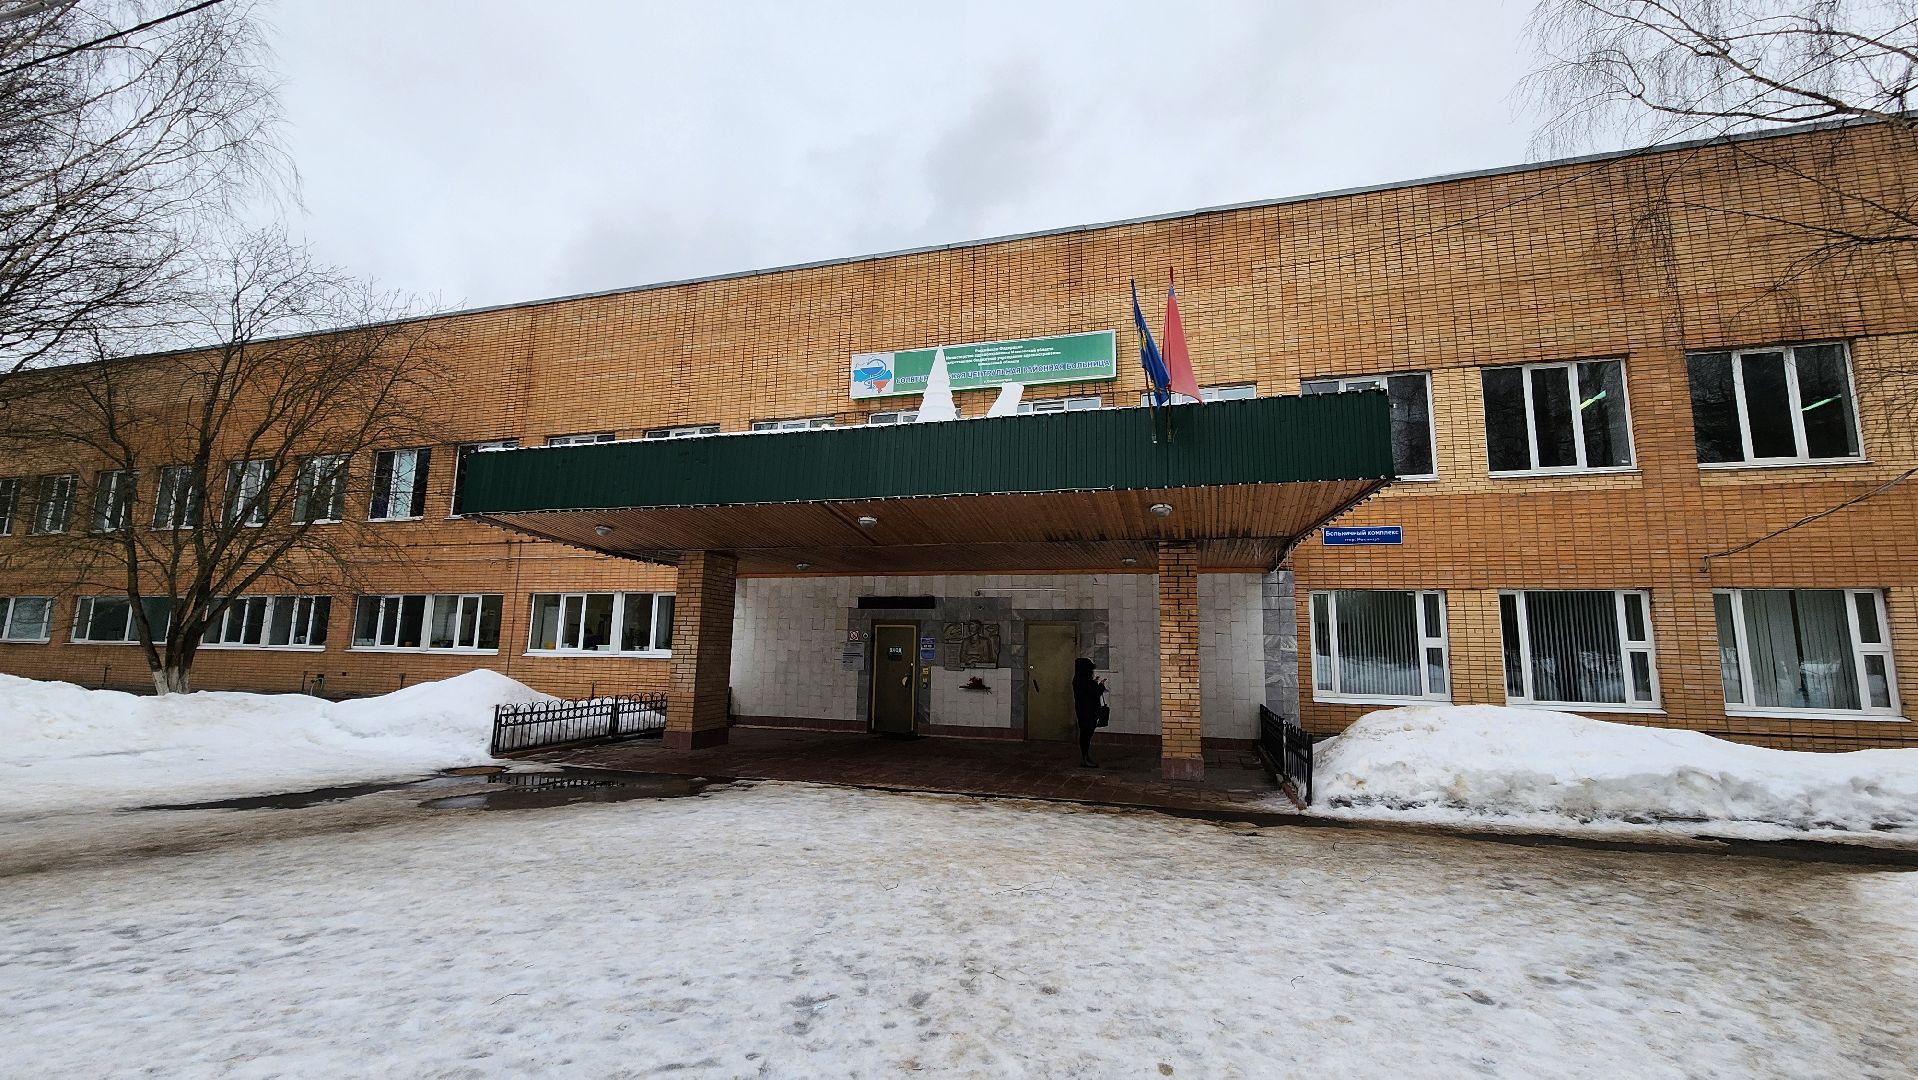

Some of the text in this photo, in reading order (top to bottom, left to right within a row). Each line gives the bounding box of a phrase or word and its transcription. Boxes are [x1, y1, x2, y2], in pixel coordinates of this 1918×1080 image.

[967, 366, 1021, 379] ЦЕНТРАЛЬНАЯ
[1023, 363, 1065, 374] РАЙОННАЯ
[1066, 359, 1110, 370] БОЛЬНИЦА
